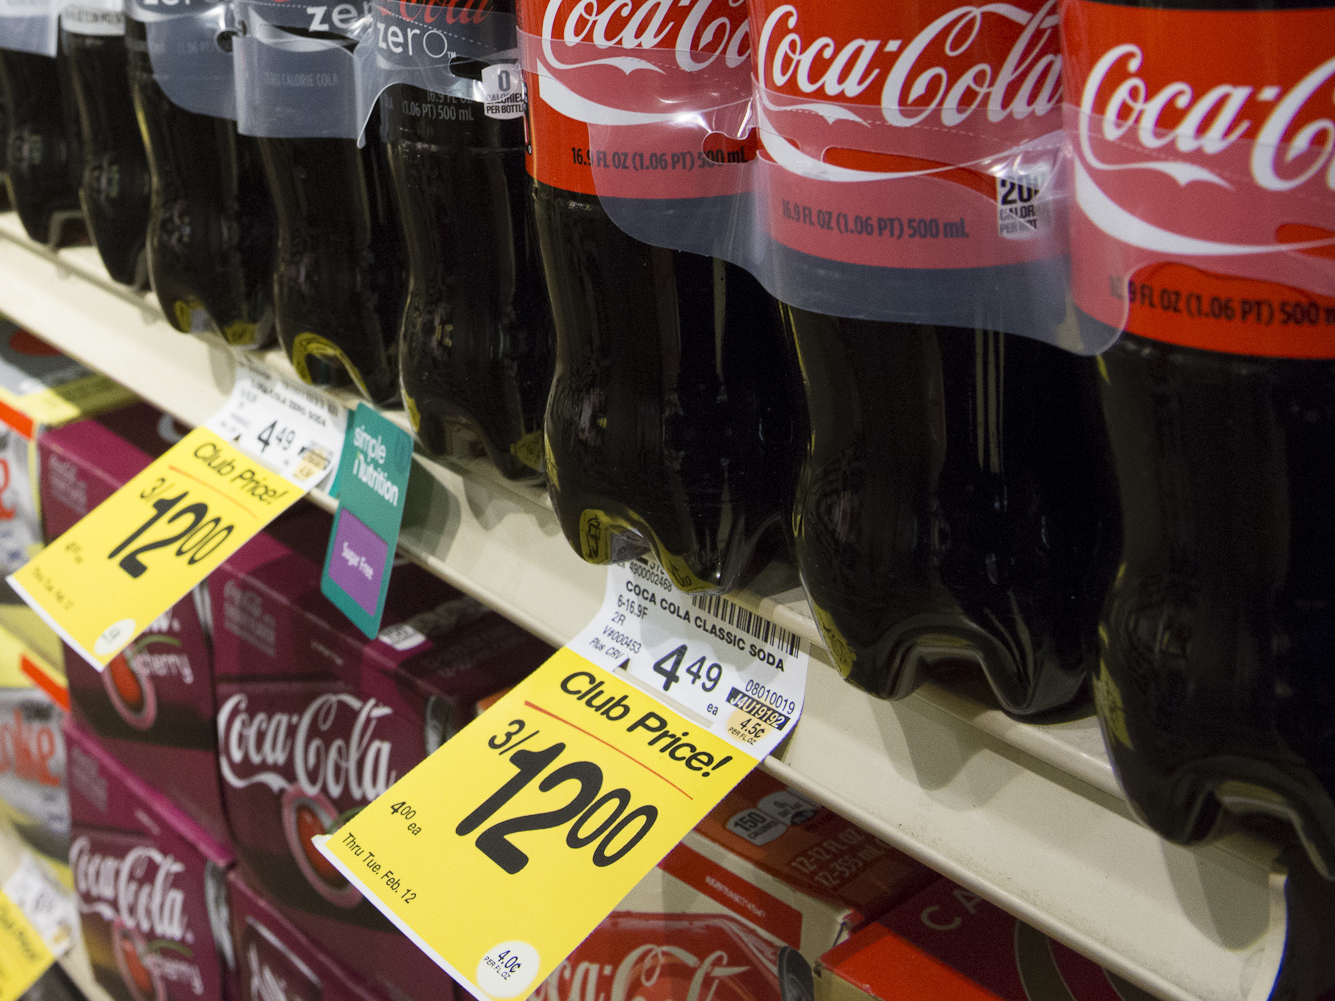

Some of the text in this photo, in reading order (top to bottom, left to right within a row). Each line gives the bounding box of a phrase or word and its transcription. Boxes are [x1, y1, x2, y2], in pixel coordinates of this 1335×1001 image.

[377, 21, 448, 59] zero
[498, 70, 511, 92] 0
[438, 105, 457, 120] 500
[486, 103, 526, 115] PER BOTTL
[571, 147, 592, 166] 16.9
[596, 150, 610, 168] FL
[612, 152, 629, 170] OZ
[632, 151, 669, 172] (1.06
[671, 151, 695, 171] PT)
[697, 150, 725, 169] 500
[802, 205, 816, 226] FL
[816, 208, 834, 231] OZ
[836, 210, 874, 236] (1.06
[877, 216, 904, 240] PT)
[907, 217, 940, 239] 500
[1138, 284, 1156, 309] FL
[1157, 288, 1182, 314] OZ
[1186, 292, 1236, 321] (1.06
[1240, 299, 1275, 326] PT)
[1279, 301, 1320, 327] 500
[353, 426, 387, 465] simple
[193, 442, 289, 506] Club Price!
[342, 541, 374, 581] Sugar Free
[611, 611, 626, 626] 2R
[617, 594, 649, 620] 6-16.9F
[625, 580, 785, 672] COCA COLA CLASSIC SODA
[589, 637, 625, 661] Plus CRV
[706, 702, 719, 717] ea
[745, 679, 796, 715] 08010019
[560, 670, 733, 778] Club Price!
[218, 693, 396, 801] Coca-Cola
[407, 822, 422, 836] ea
[734, 811, 765, 833] 150
[342, 832, 417, 904] Thru Tue. Feb. 12
[483, 955, 497, 969] PER
